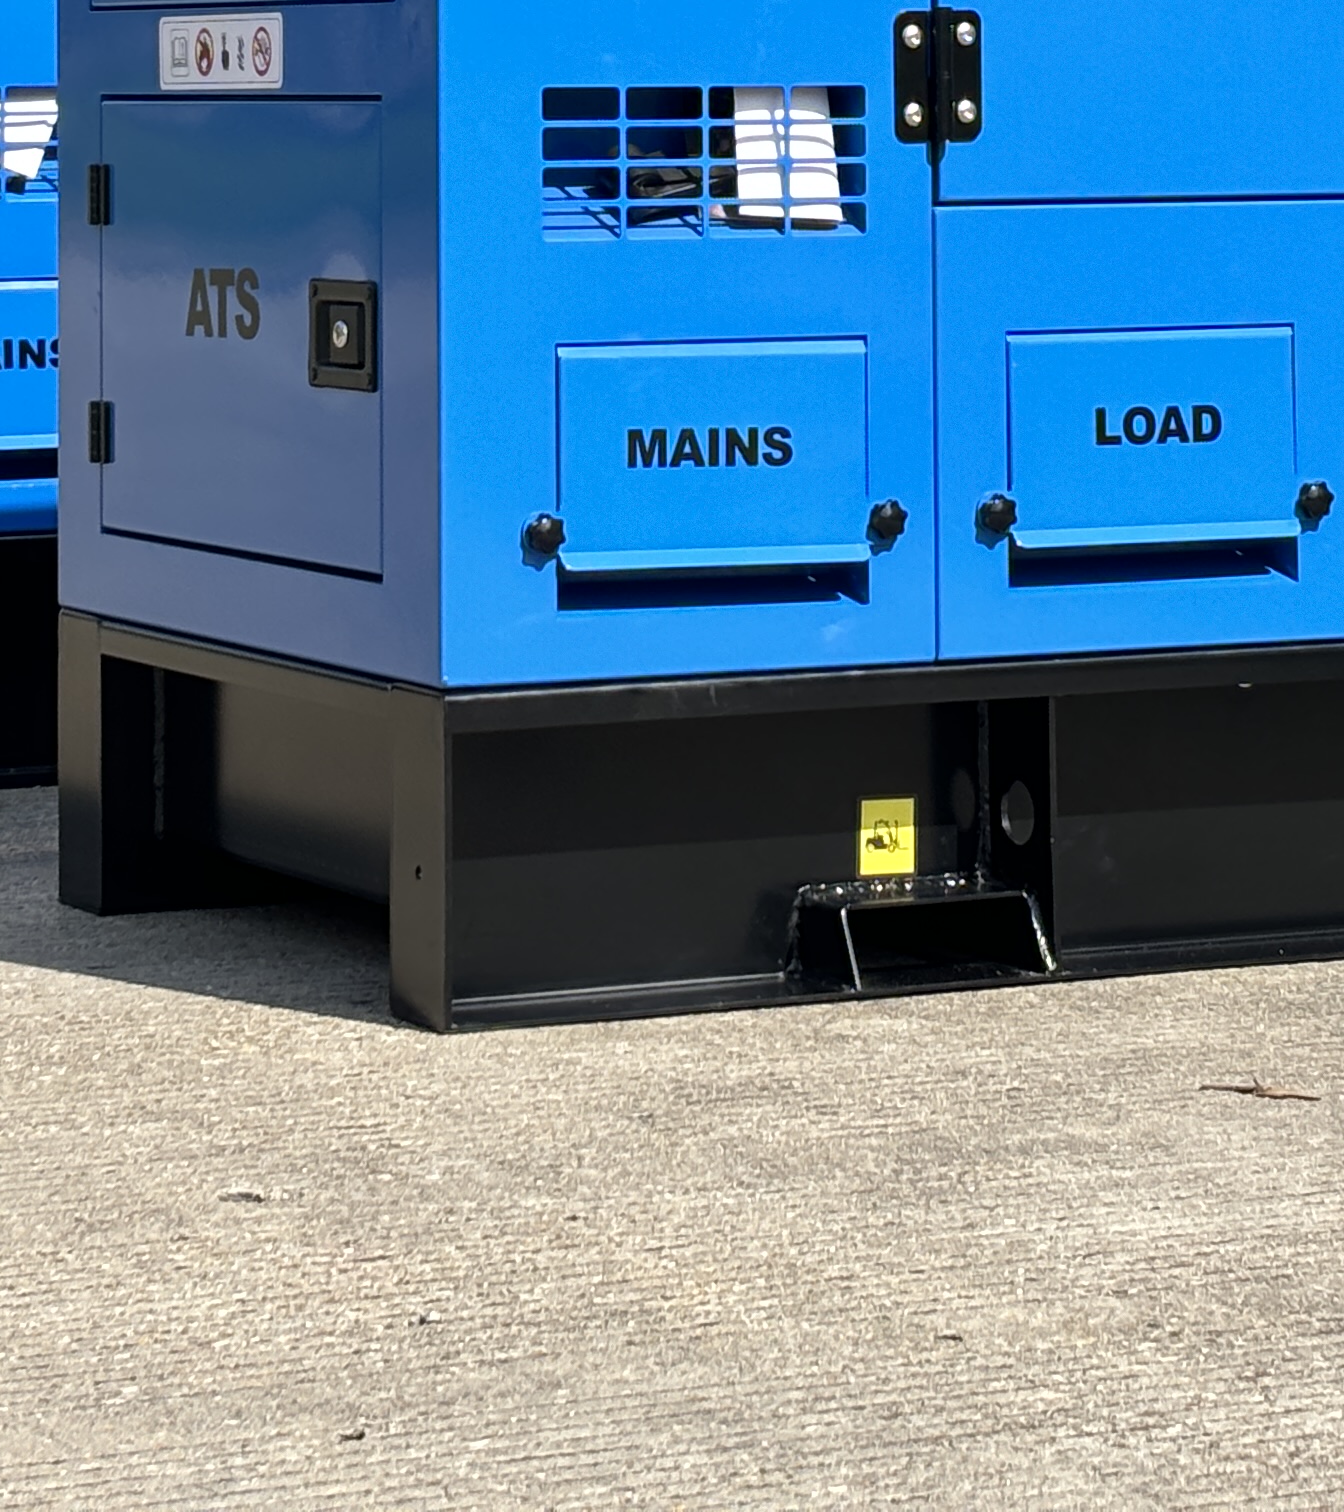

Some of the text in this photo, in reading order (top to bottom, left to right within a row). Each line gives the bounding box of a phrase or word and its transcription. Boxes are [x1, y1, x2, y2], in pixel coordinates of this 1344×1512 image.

[185, 267, 261, 340] ATS
[1094, 405, 1222, 446] LOAD
[626, 426, 794, 469] MAINS
